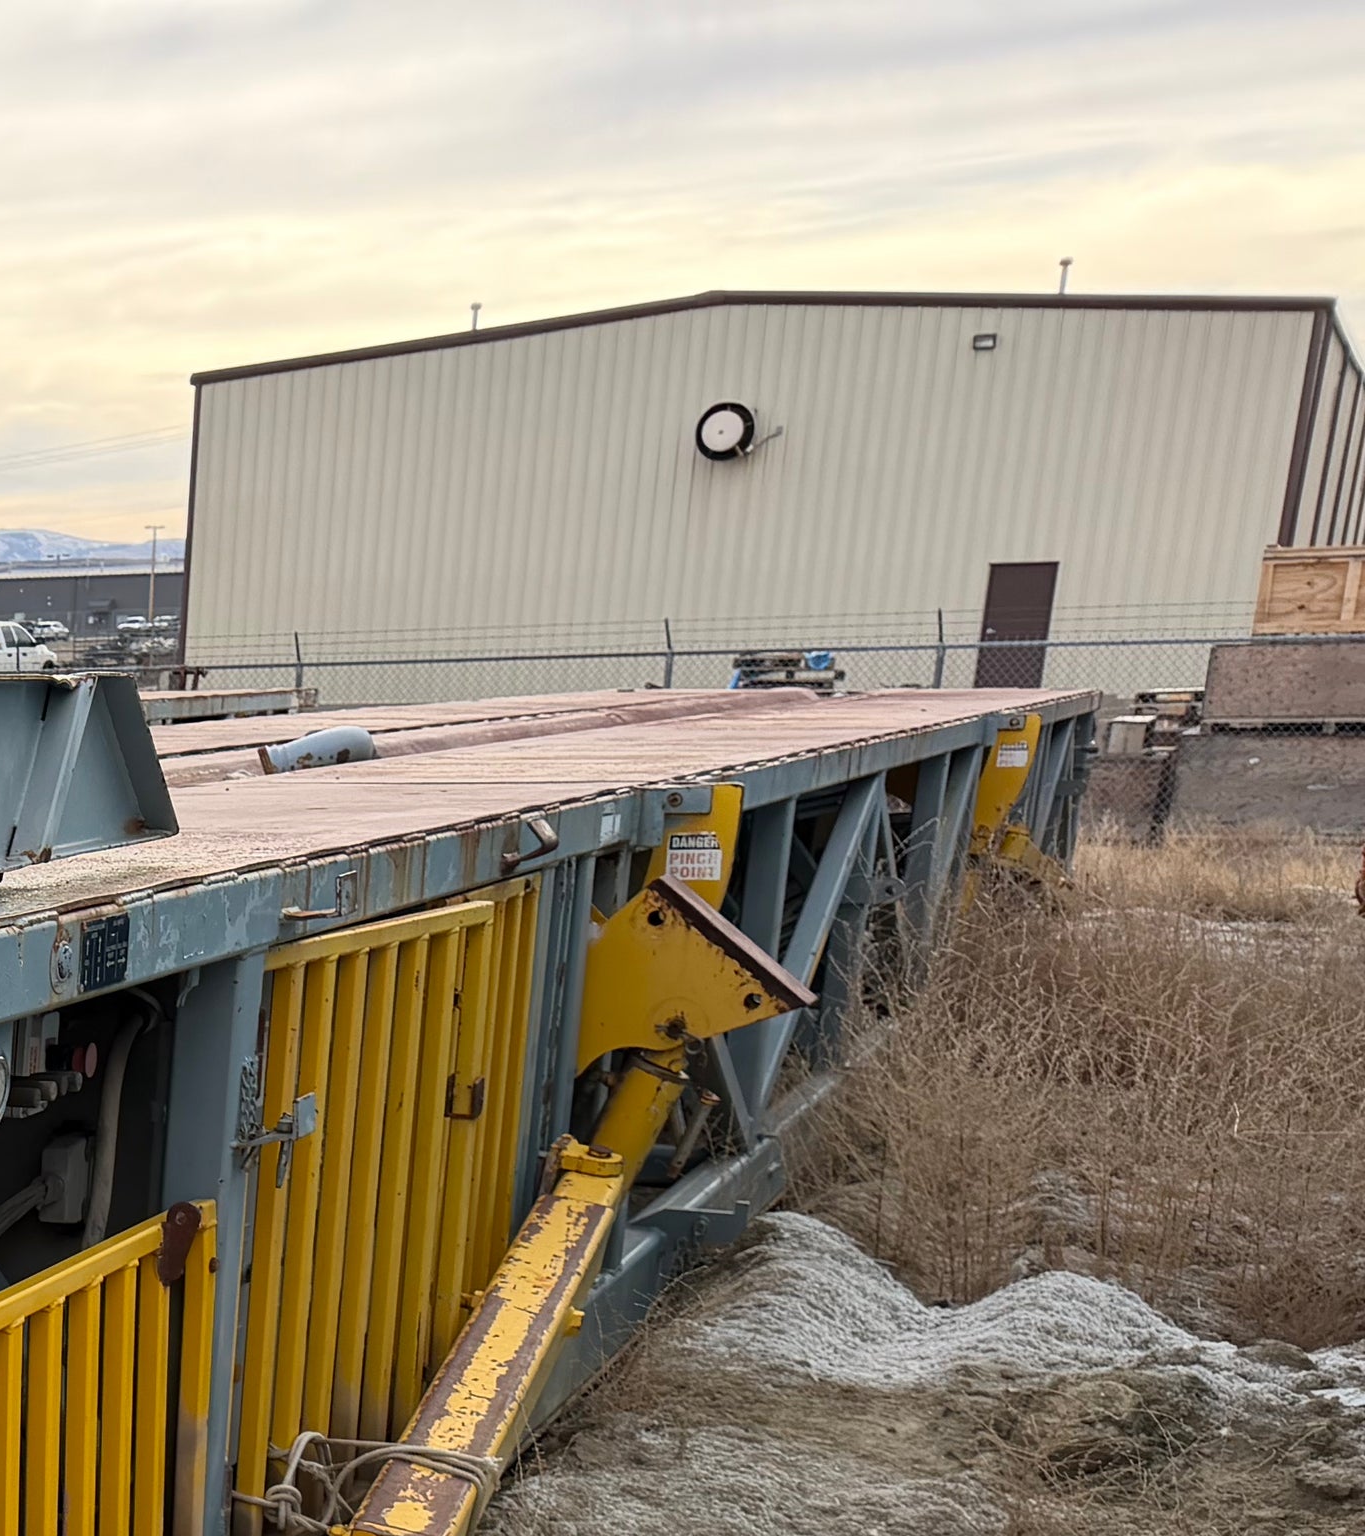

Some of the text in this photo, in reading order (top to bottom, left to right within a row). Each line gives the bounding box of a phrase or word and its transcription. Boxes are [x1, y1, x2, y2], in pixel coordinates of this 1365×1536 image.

[671, 836, 719, 848] DANGER
[670, 852, 718, 864] PINCH
[670, 866, 714, 878] POINT
